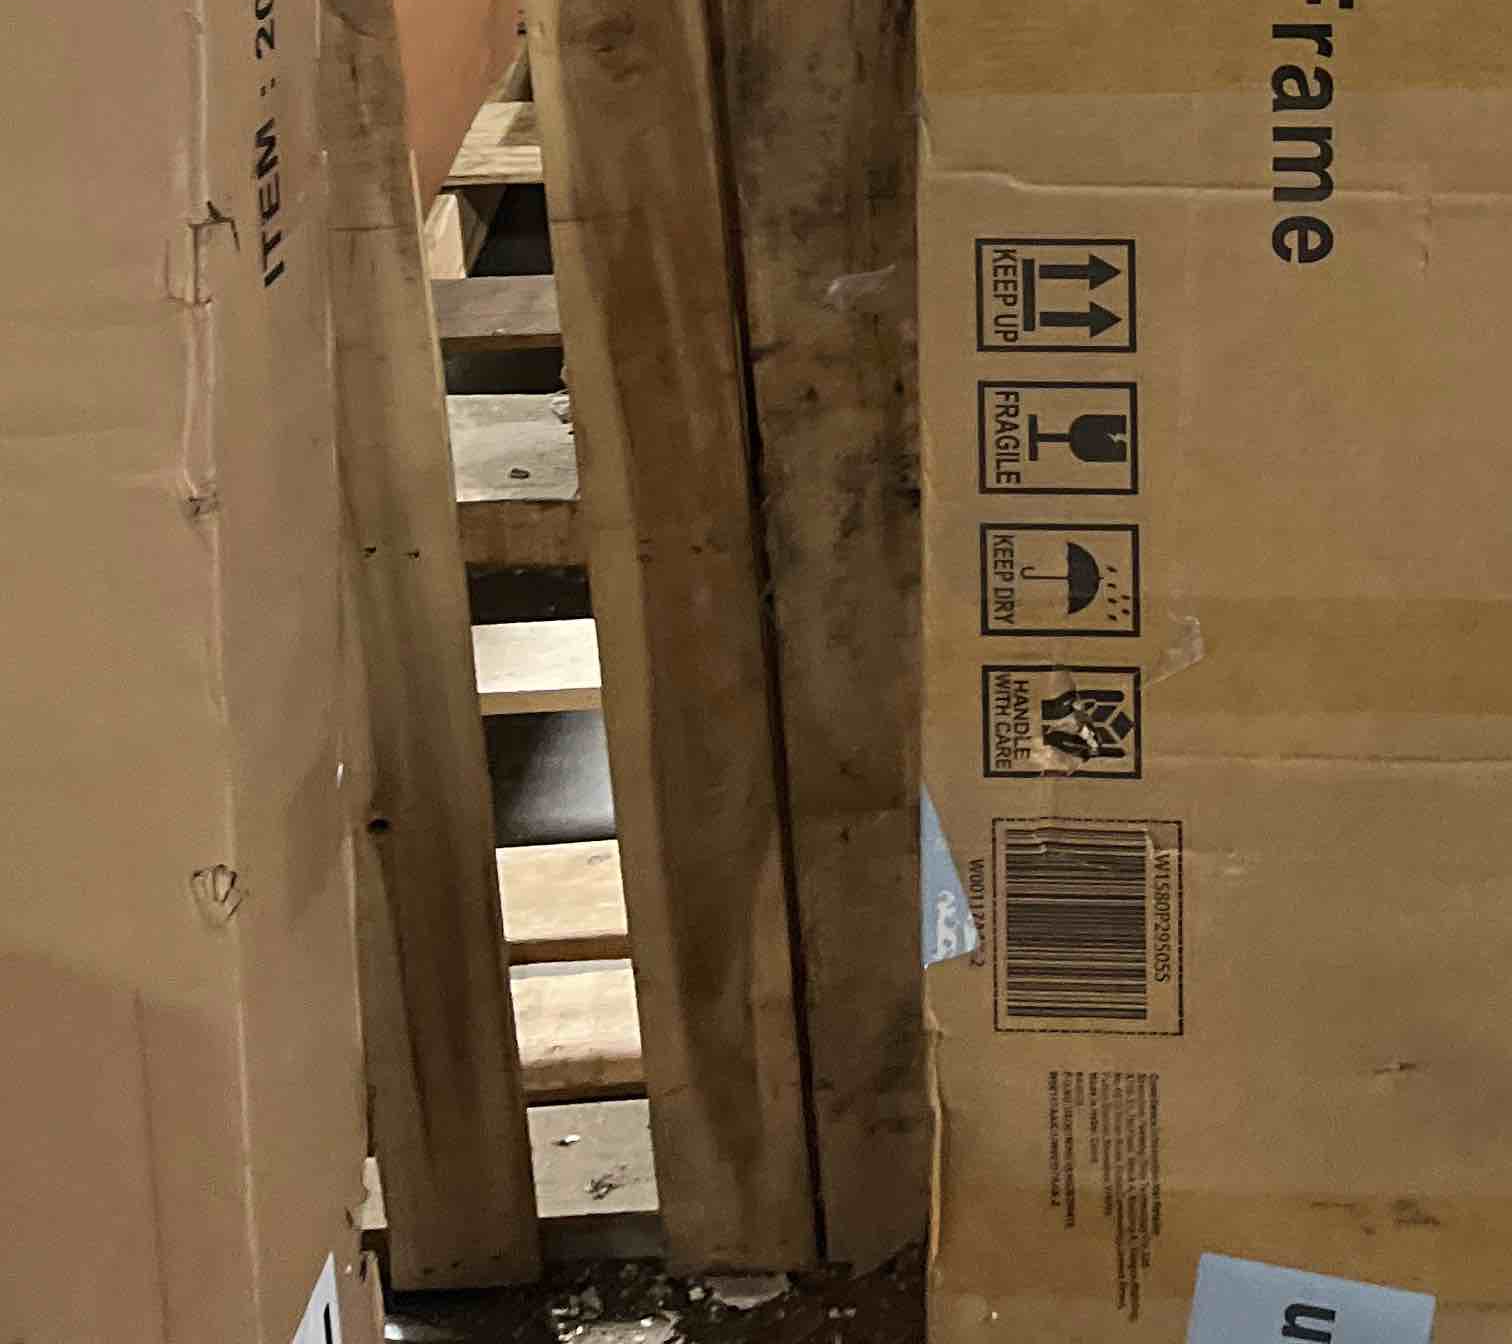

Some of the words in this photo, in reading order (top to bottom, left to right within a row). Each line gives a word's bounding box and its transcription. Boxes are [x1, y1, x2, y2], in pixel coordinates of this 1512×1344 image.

[257, 128, 289, 288] ITEM
[992, 248, 1017, 307] KEEP
[992, 312, 1017, 343] UP
[992, 391, 1019, 484] FRAGILE
[991, 534, 1014, 583] KEEP
[993, 586, 1015, 626] DRY
[994, 672, 1010, 715] WITH
[996, 719, 1012, 769] CARE
[1012, 679, 1030, 760] HANDLE
